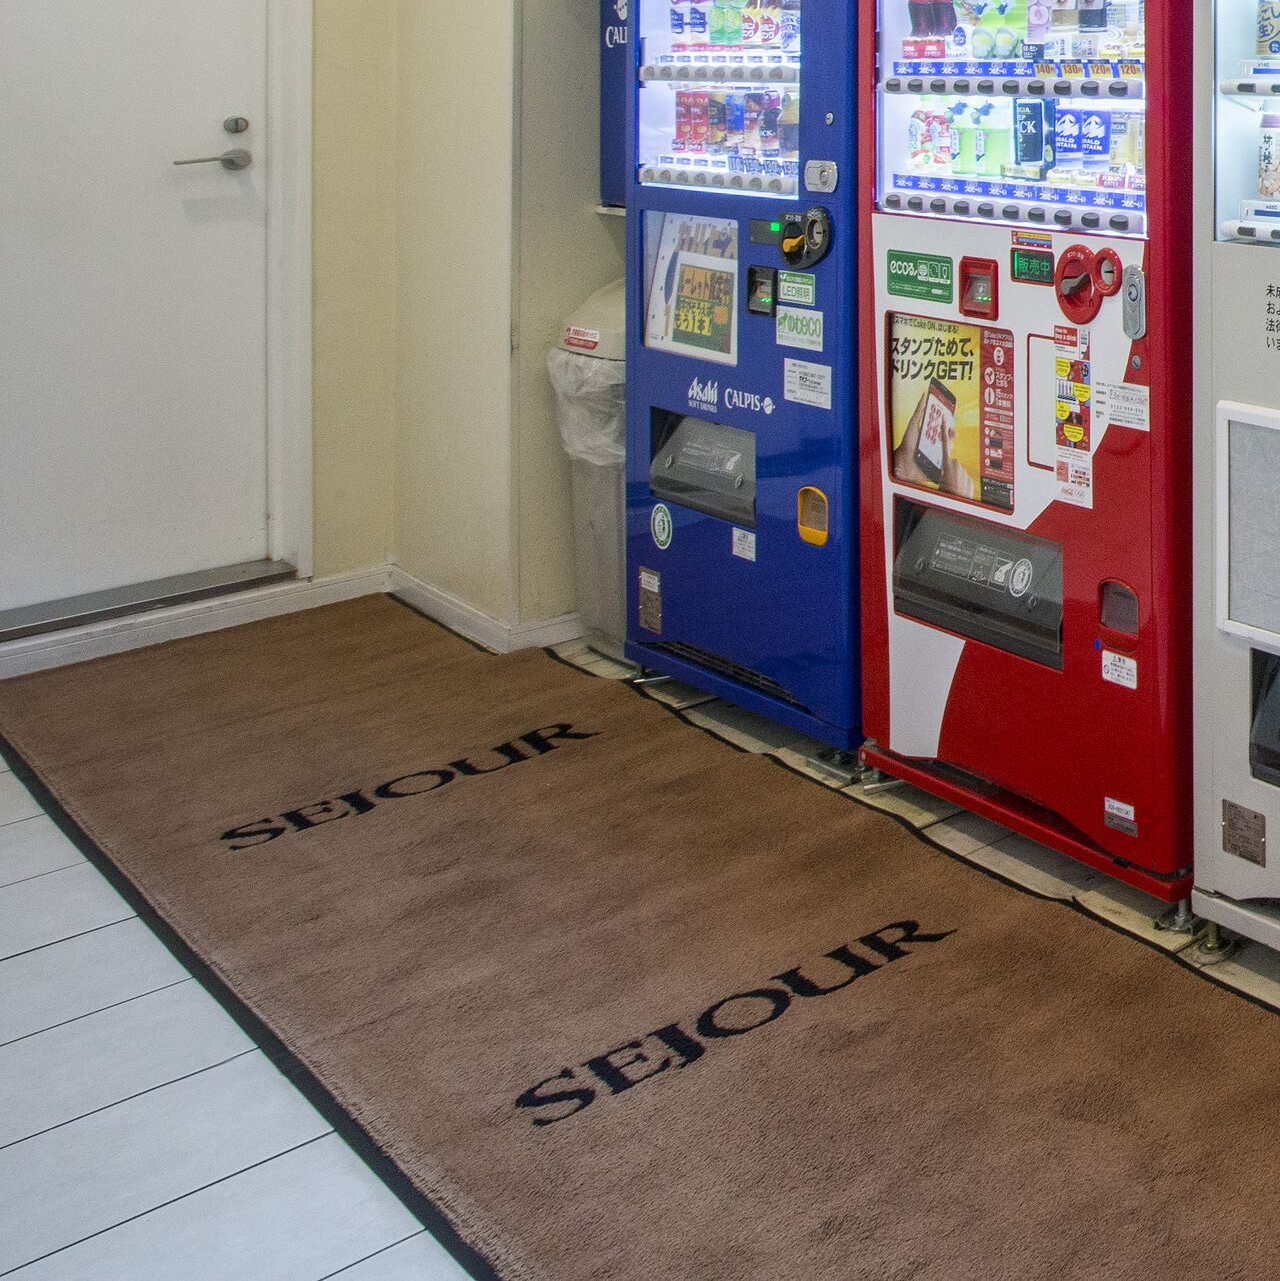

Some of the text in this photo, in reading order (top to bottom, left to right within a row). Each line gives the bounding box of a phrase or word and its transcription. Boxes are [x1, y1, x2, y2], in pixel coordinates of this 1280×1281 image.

[1017, 255, 1051, 275] 販売中
[687, 376, 718, 403] Asahi
[724, 387, 761, 411] CALPIS
